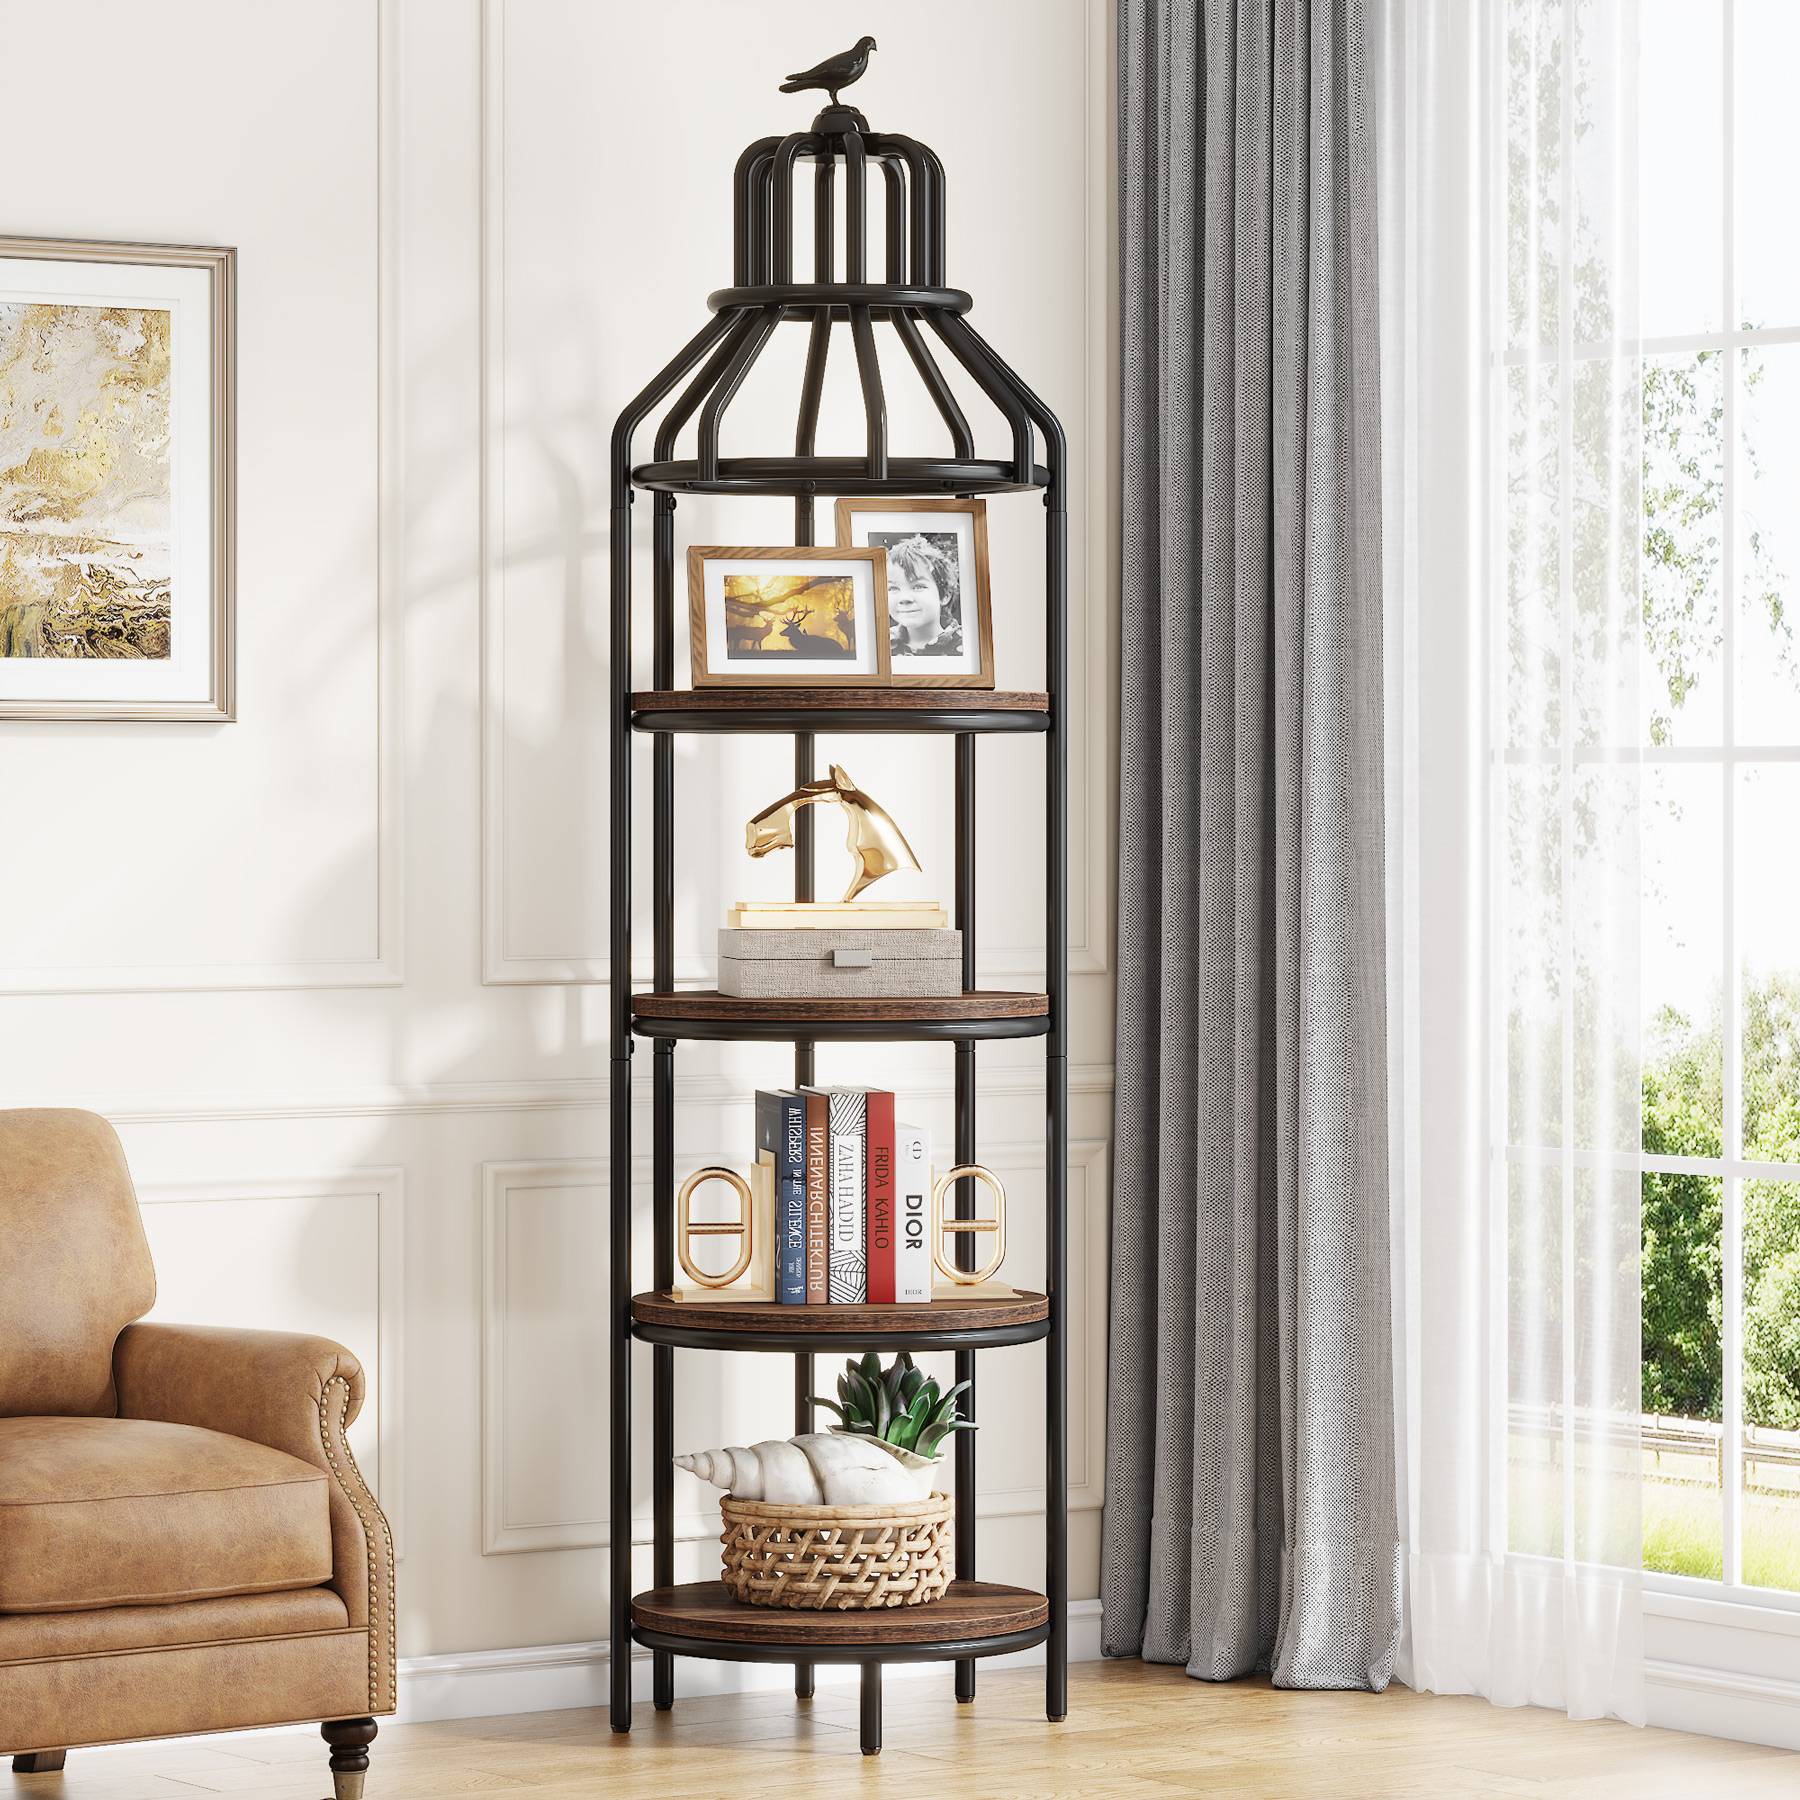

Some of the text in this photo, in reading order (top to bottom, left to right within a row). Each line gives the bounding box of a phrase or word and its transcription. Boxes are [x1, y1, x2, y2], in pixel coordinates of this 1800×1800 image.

[839, 1144, 854, 1242] ZAHA HADID
[874, 1147, 889, 1249] FRIDA KAHLO
[905, 1194, 923, 1250] DIOR
